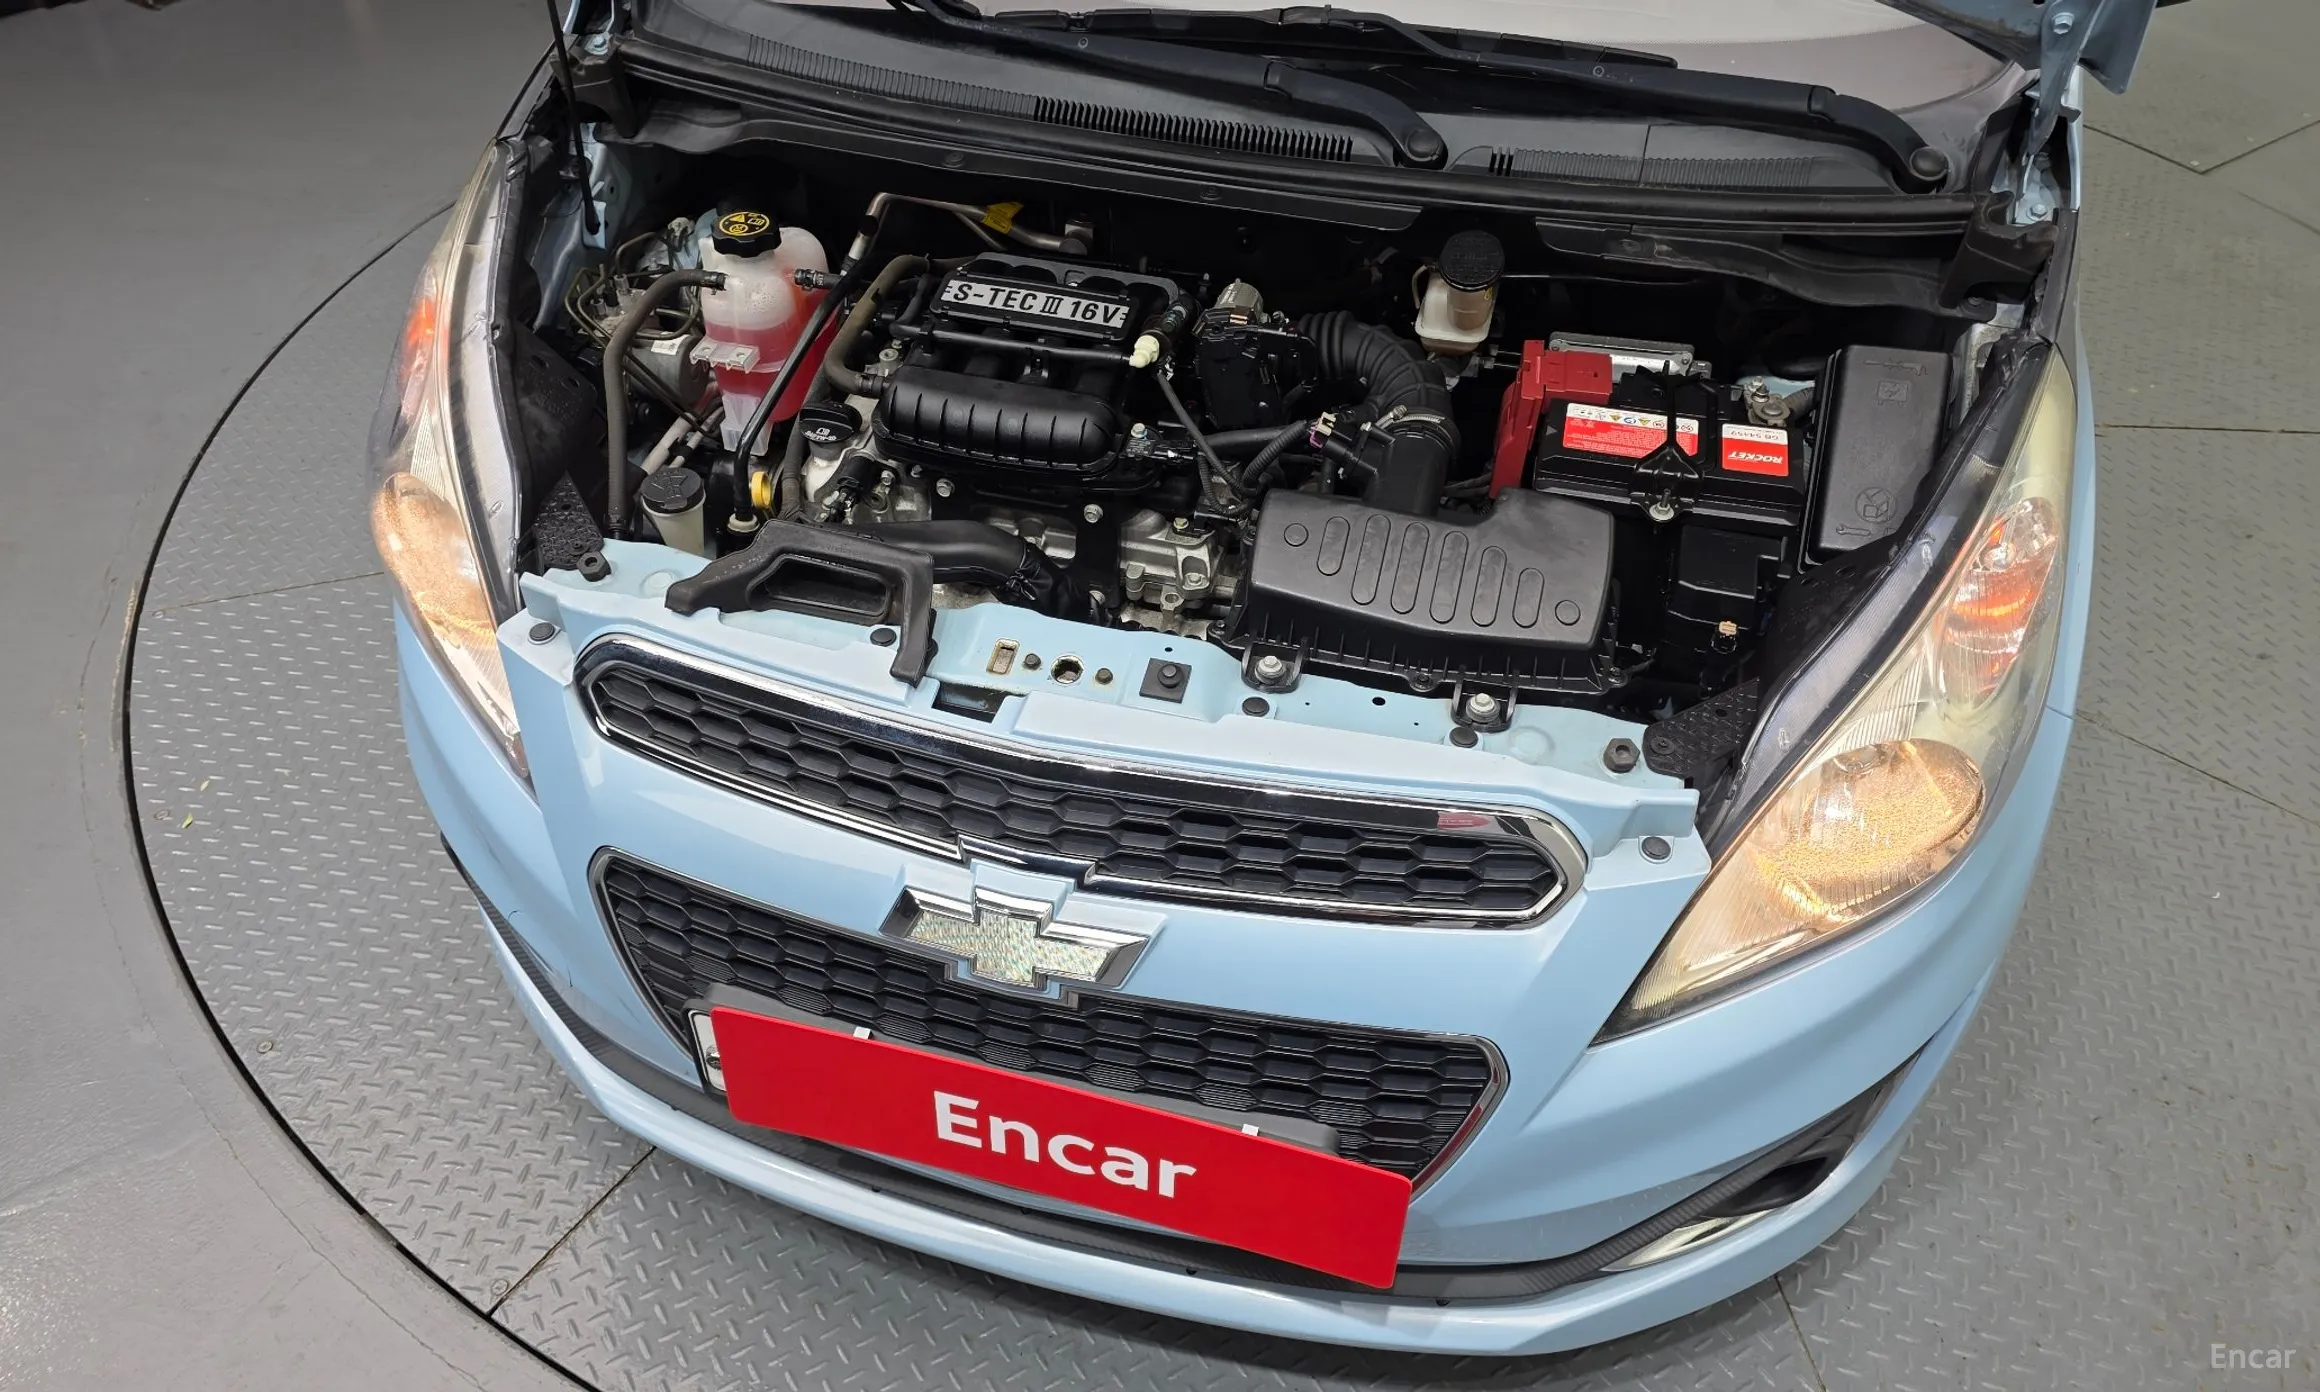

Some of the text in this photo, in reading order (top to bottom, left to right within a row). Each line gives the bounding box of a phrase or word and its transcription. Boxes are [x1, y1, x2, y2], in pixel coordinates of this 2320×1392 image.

[953, 283, 1038, 311] S-TEC
[1070, 300, 1121, 324] 16V
[1728, 451, 1783, 464] ROCKET
[933, 1090, 1197, 1198] Encar
